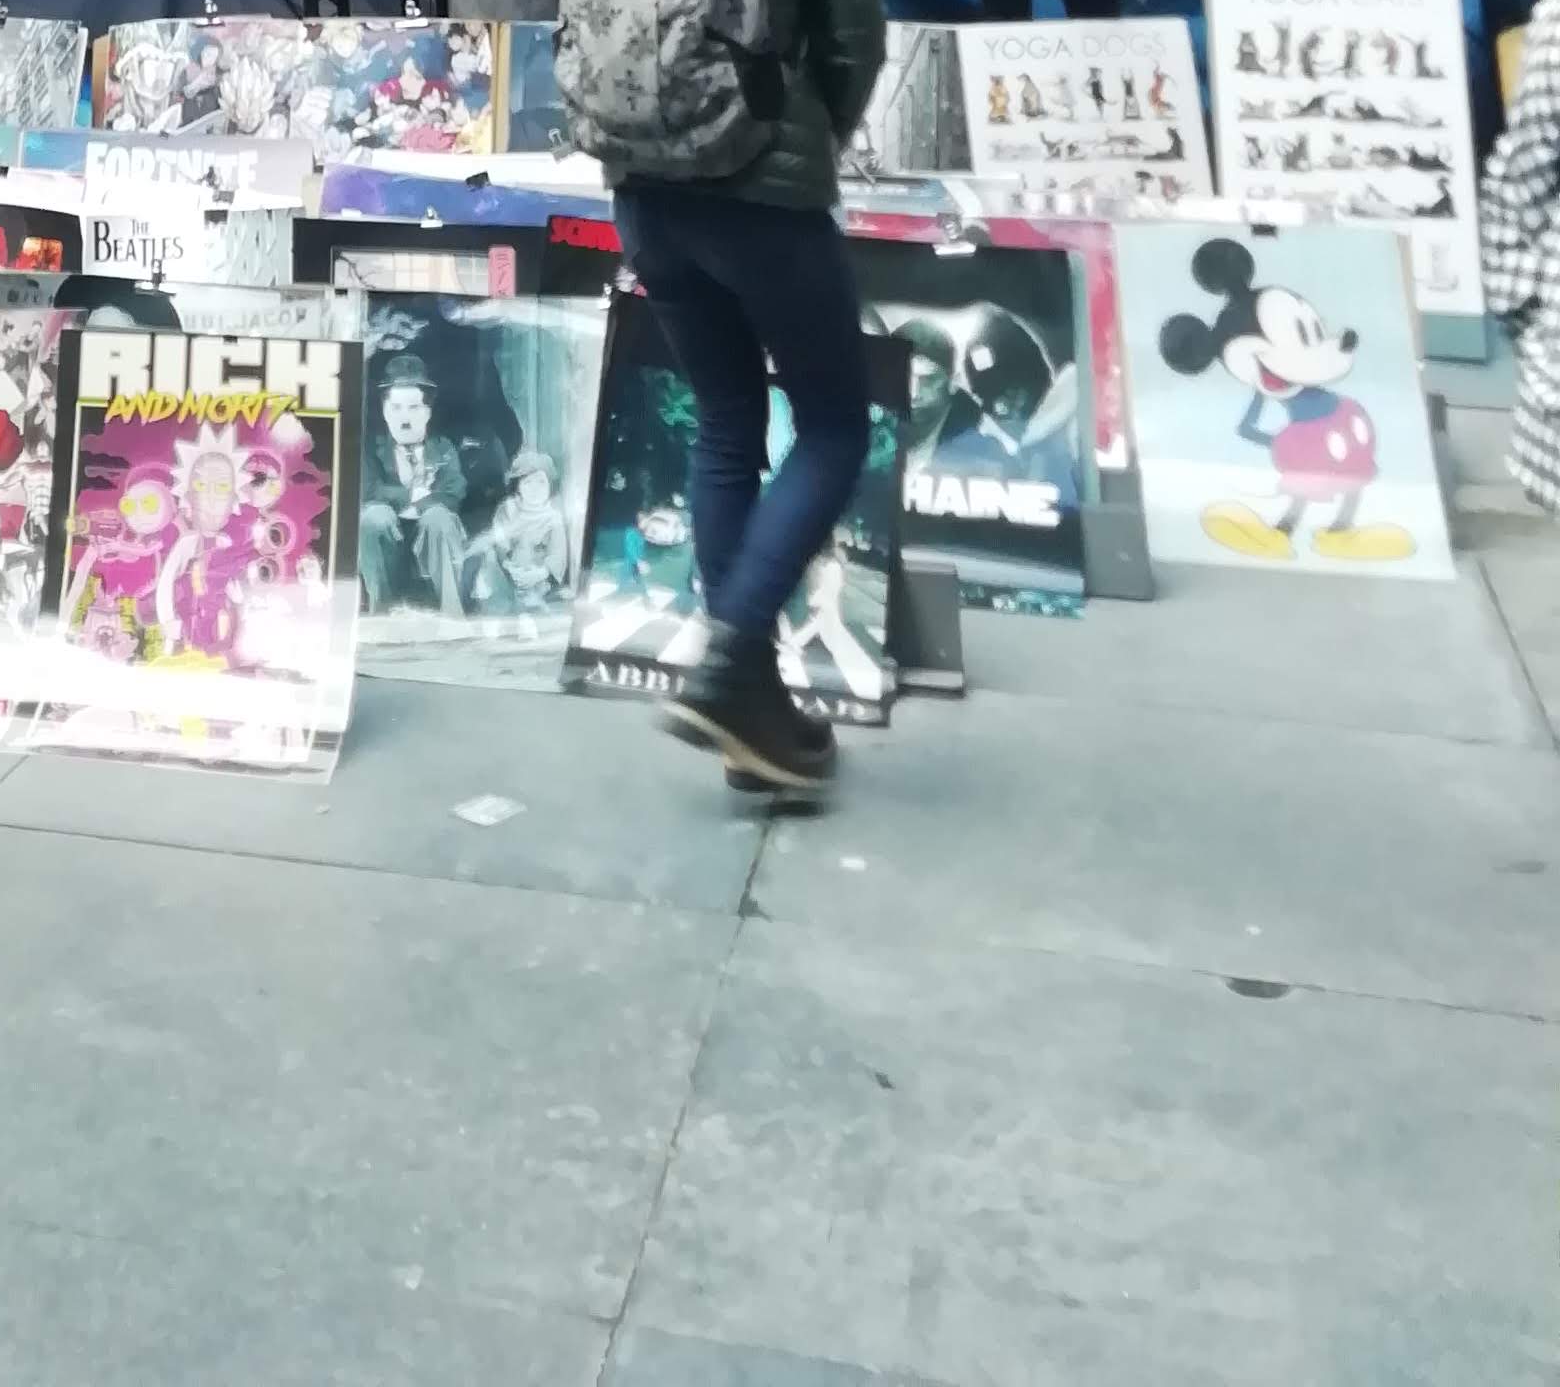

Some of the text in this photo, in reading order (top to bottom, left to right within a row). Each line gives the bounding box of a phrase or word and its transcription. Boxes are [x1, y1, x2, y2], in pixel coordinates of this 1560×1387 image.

[983, 31, 1169, 62] YOGA DOGS
[92, 219, 185, 269] BEATLES
[131, 218, 150, 236] THE
[78, 331, 341, 410] RICK
[104, 388, 299, 427] AND MORTY
[584, 660, 687, 694] ABB
